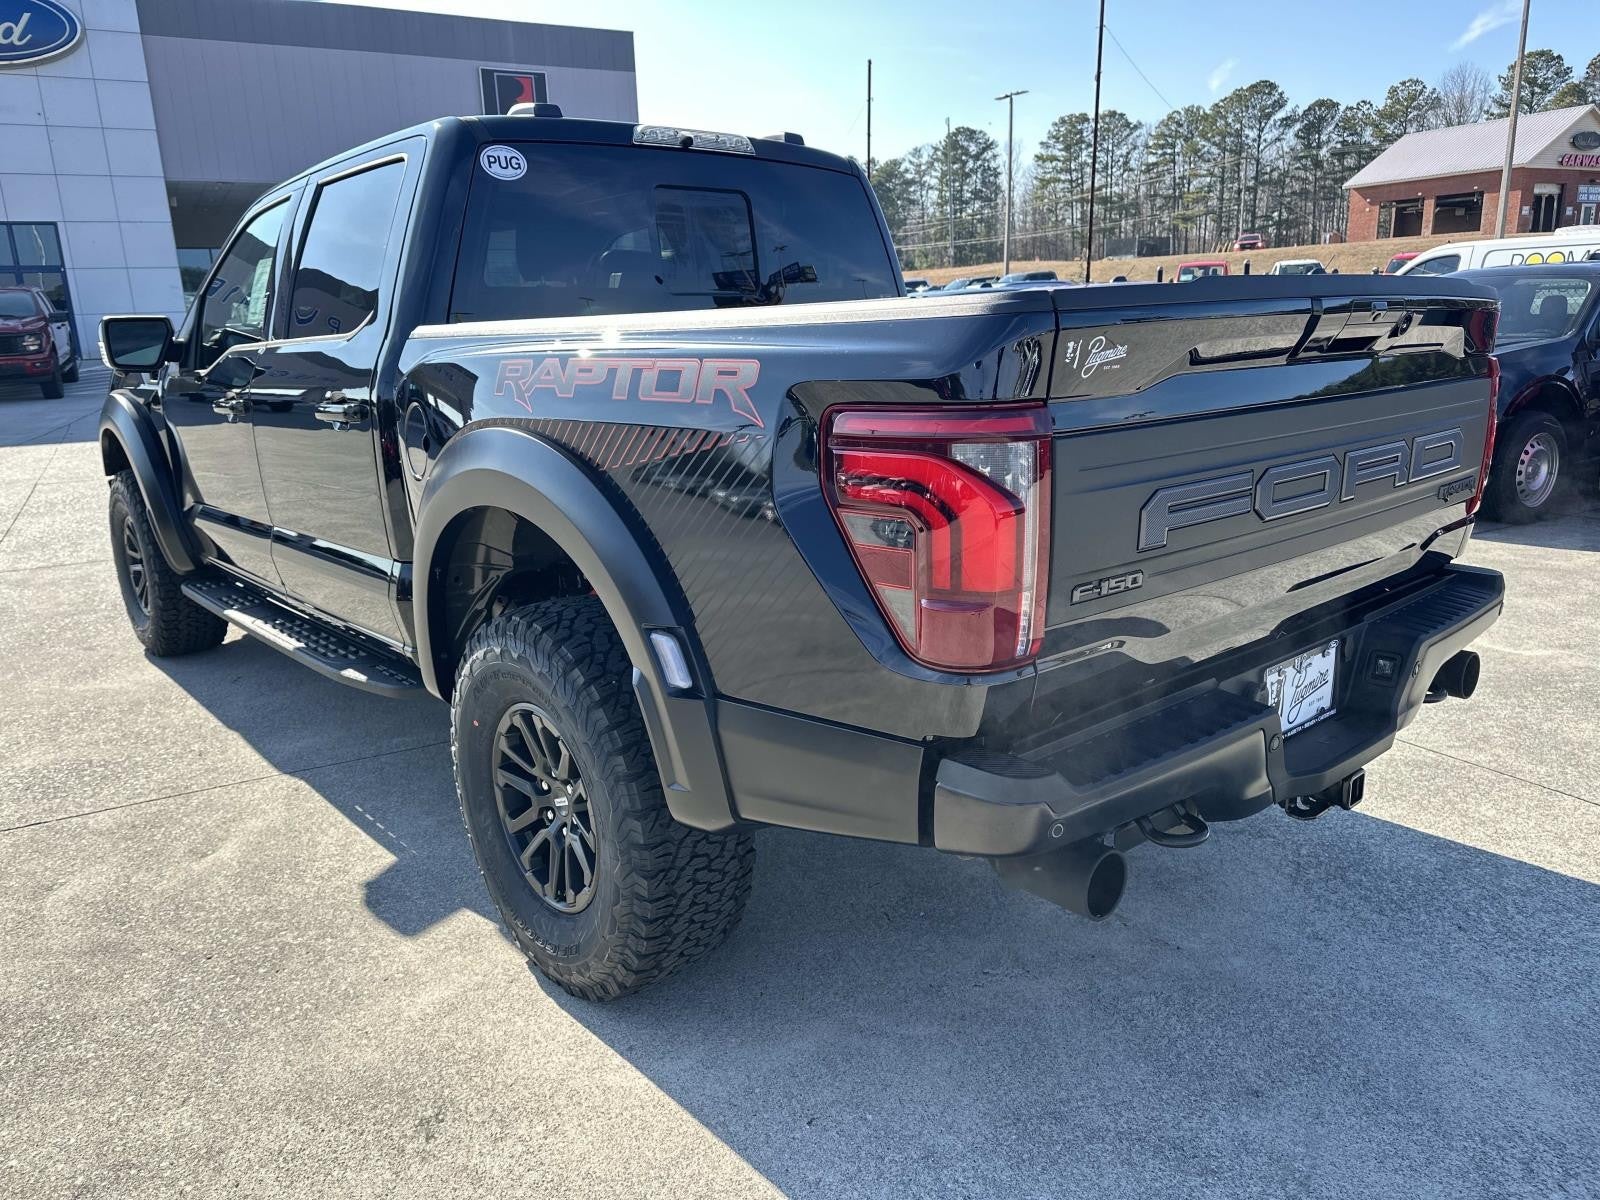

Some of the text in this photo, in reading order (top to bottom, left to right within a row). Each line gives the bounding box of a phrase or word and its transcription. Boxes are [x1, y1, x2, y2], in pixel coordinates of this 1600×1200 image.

[486, 154, 522, 170] PUG
[1082, 335, 1128, 378] Pugmire
[494, 357, 765, 429] RAPTOR
[1137, 426, 1465, 554] FORD
[1070, 569, 1143, 605] F-150
[1287, 662, 1329, 725] Pugmire
